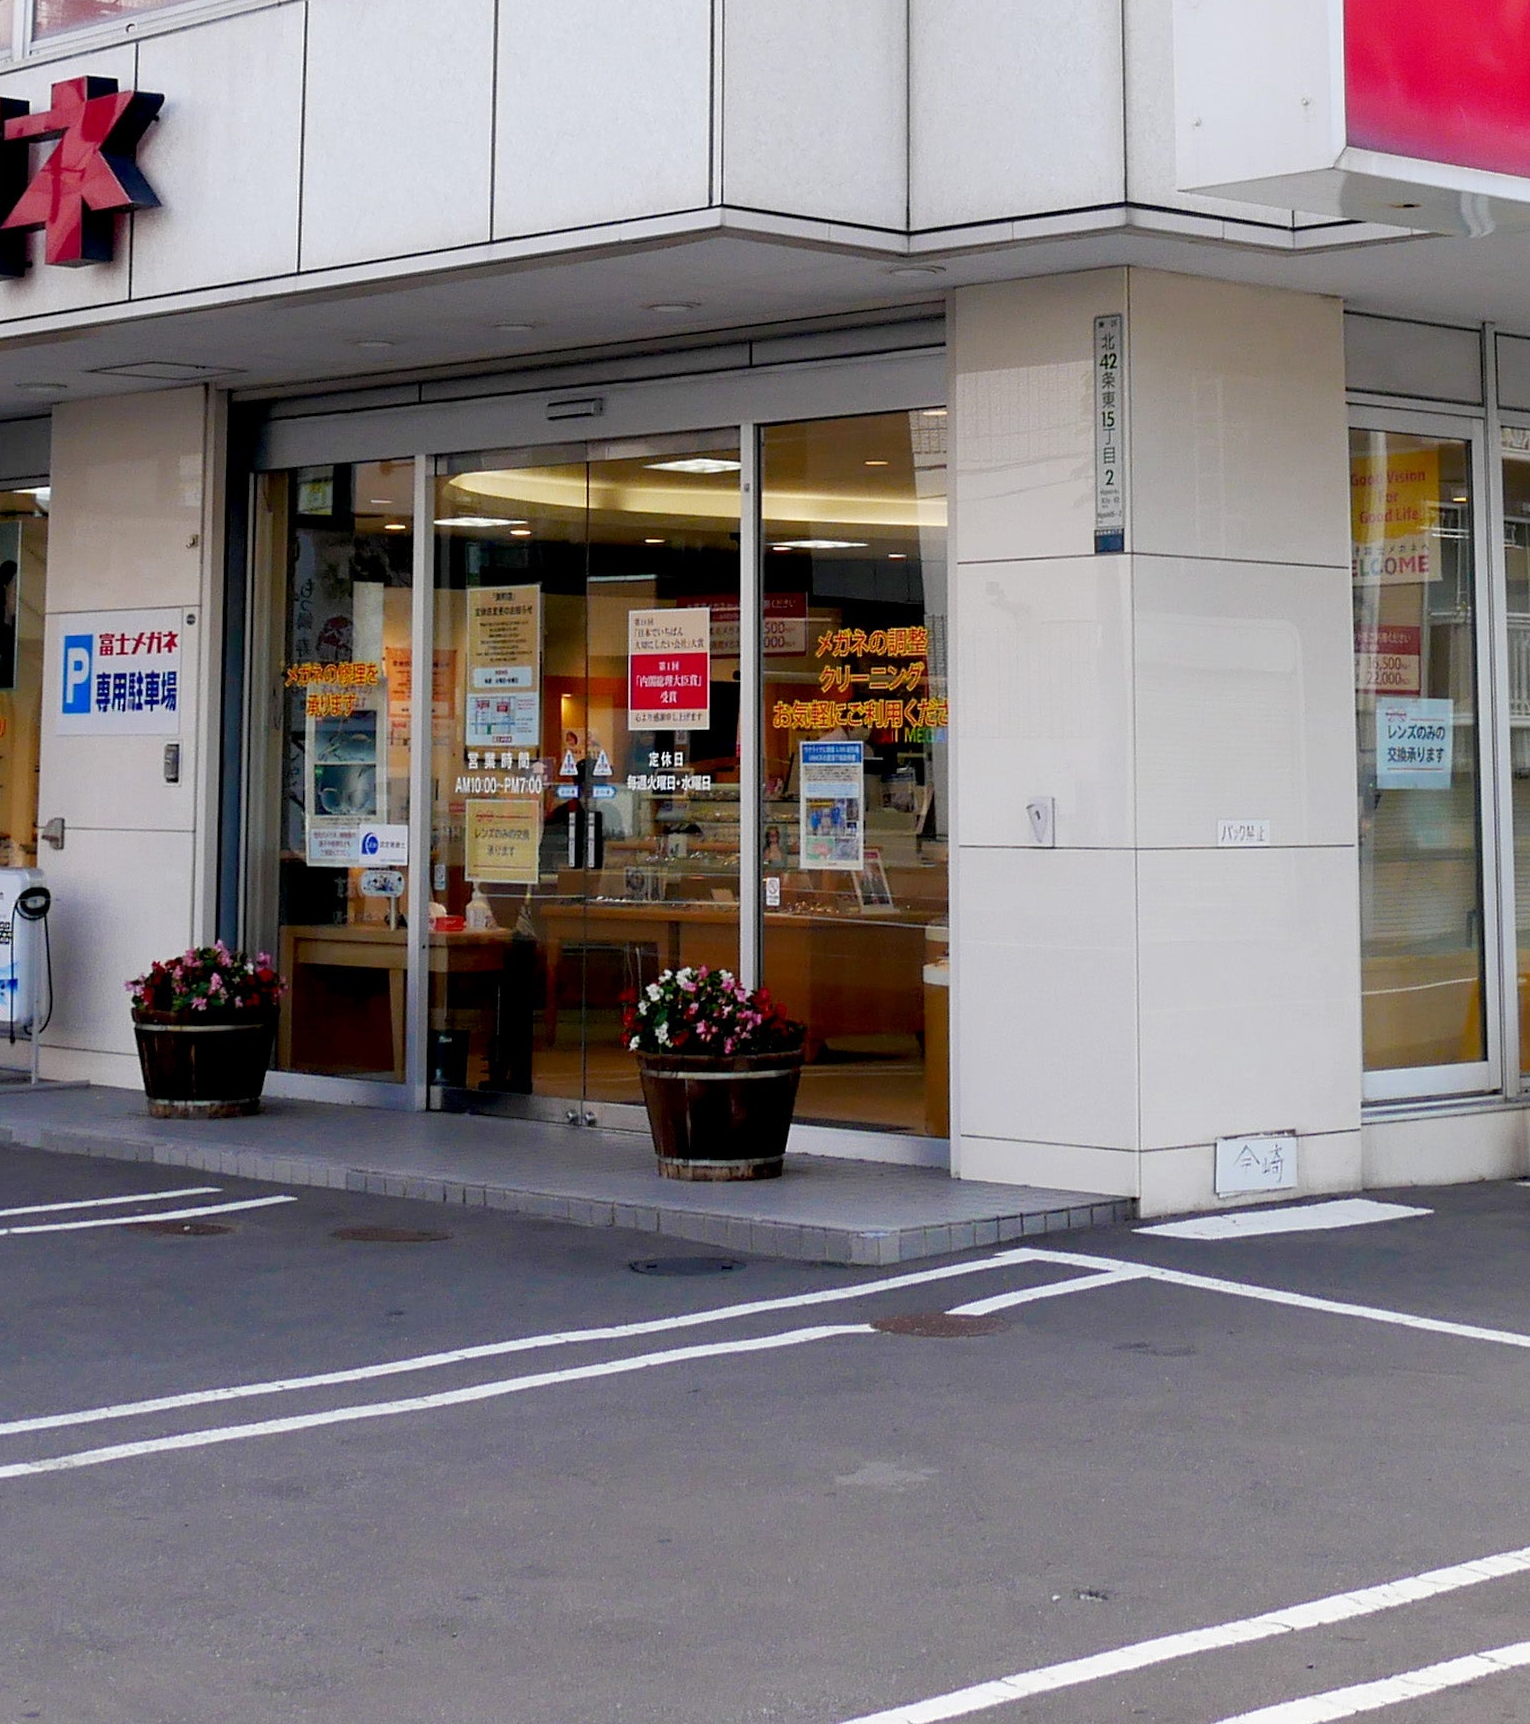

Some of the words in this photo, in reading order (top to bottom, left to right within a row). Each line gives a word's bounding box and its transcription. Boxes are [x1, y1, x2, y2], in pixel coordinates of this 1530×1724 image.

[1387, 470, 1426, 484] Vision
[1359, 508, 1393, 524] Good
[1396, 506, 1420, 522] Life
[99, 631, 178, 656] 富士メガネ
[815, 626, 929, 658] メガネの調整
[65, 646, 91, 704] P
[284, 662, 380, 687] メガネの修理を
[818, 661, 926, 694] クリーニング
[96, 670, 177, 713] 専用駐車場
[306, 694, 357, 717] 承ります
[1387, 725, 1446, 741] レンズのみの
[467, 751, 530, 770] 営業時間
[647, 751, 684, 768] 定休日
[1387, 746, 1446, 764] 交換承ります
[627, 774, 712, 792] 毎週火曜日・水曜日
